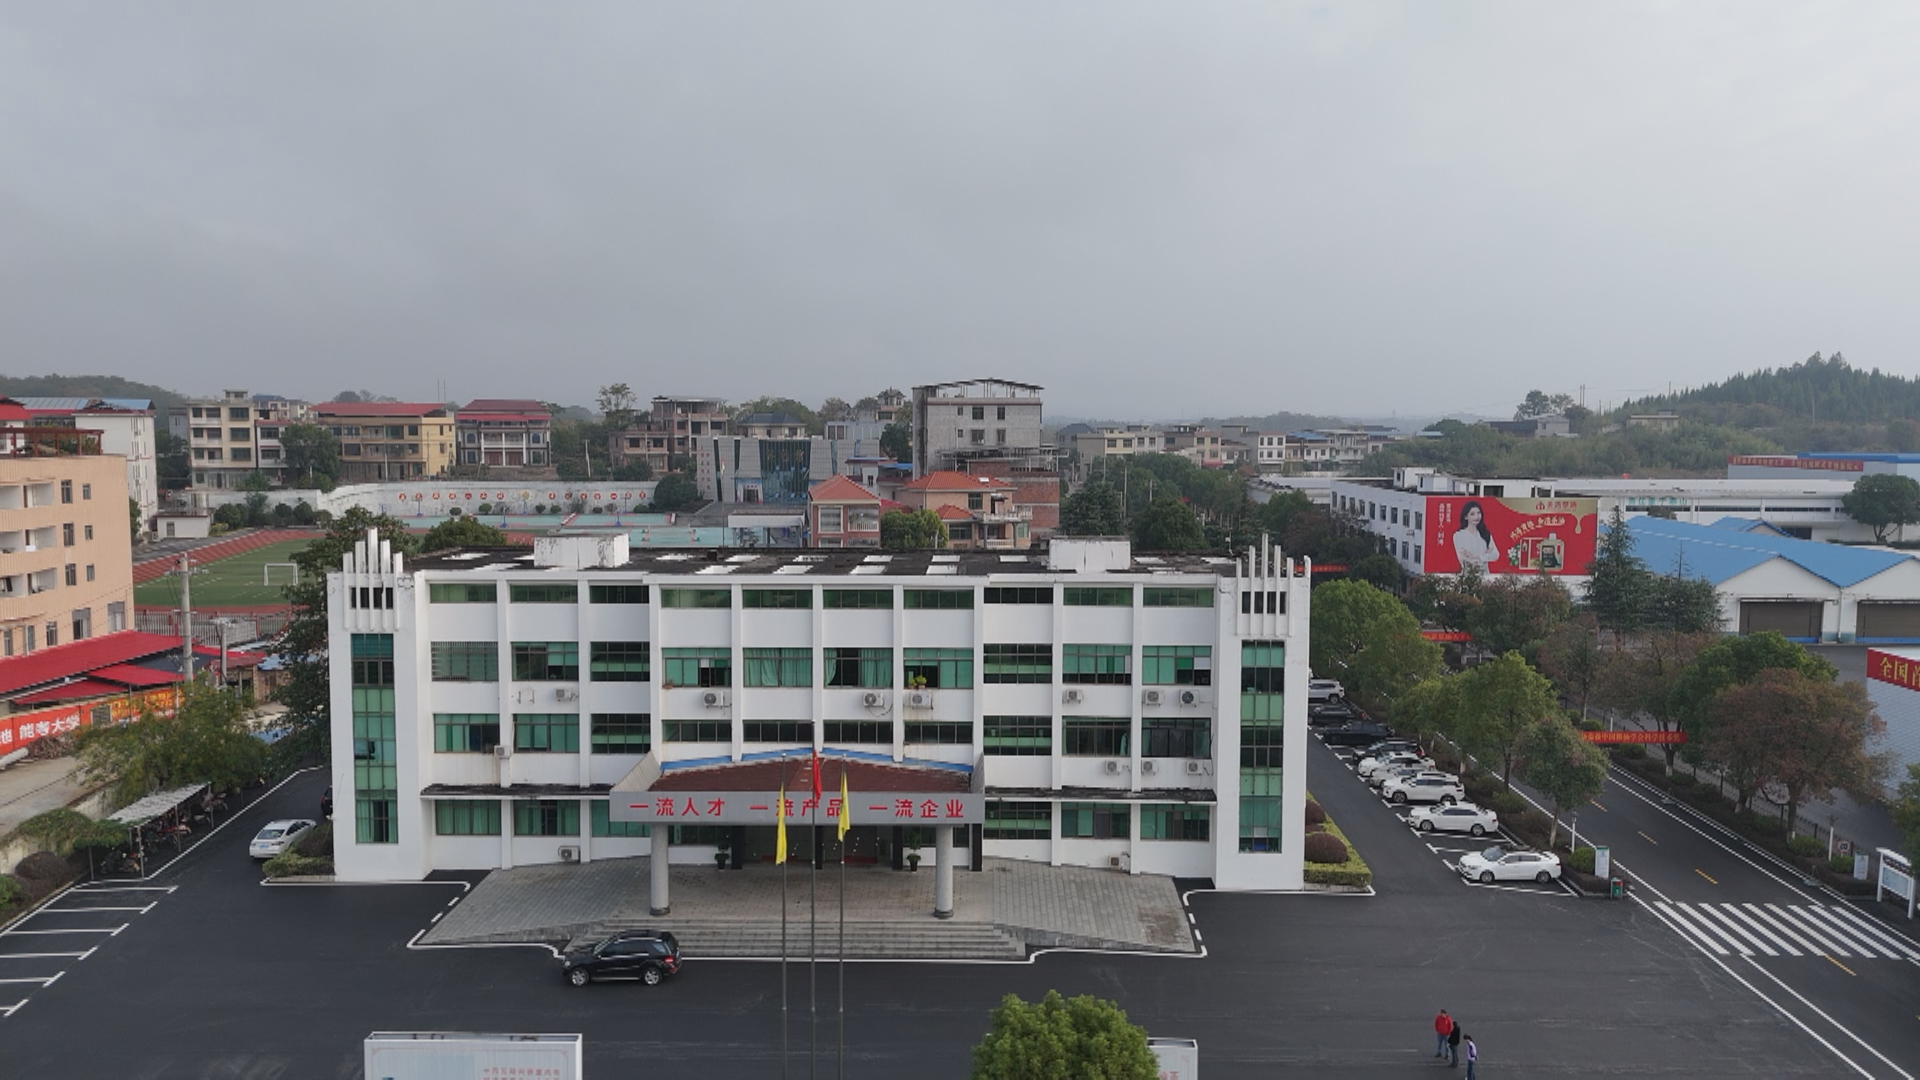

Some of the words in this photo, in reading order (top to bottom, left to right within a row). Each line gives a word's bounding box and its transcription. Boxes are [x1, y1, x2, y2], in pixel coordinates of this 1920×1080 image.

[19, 713, 80, 741] 能考大学
[629, 797, 726, 817] 一流人才
[750, 798, 843, 818] 一流产品
[869, 798, 964, 819] 一流企业
